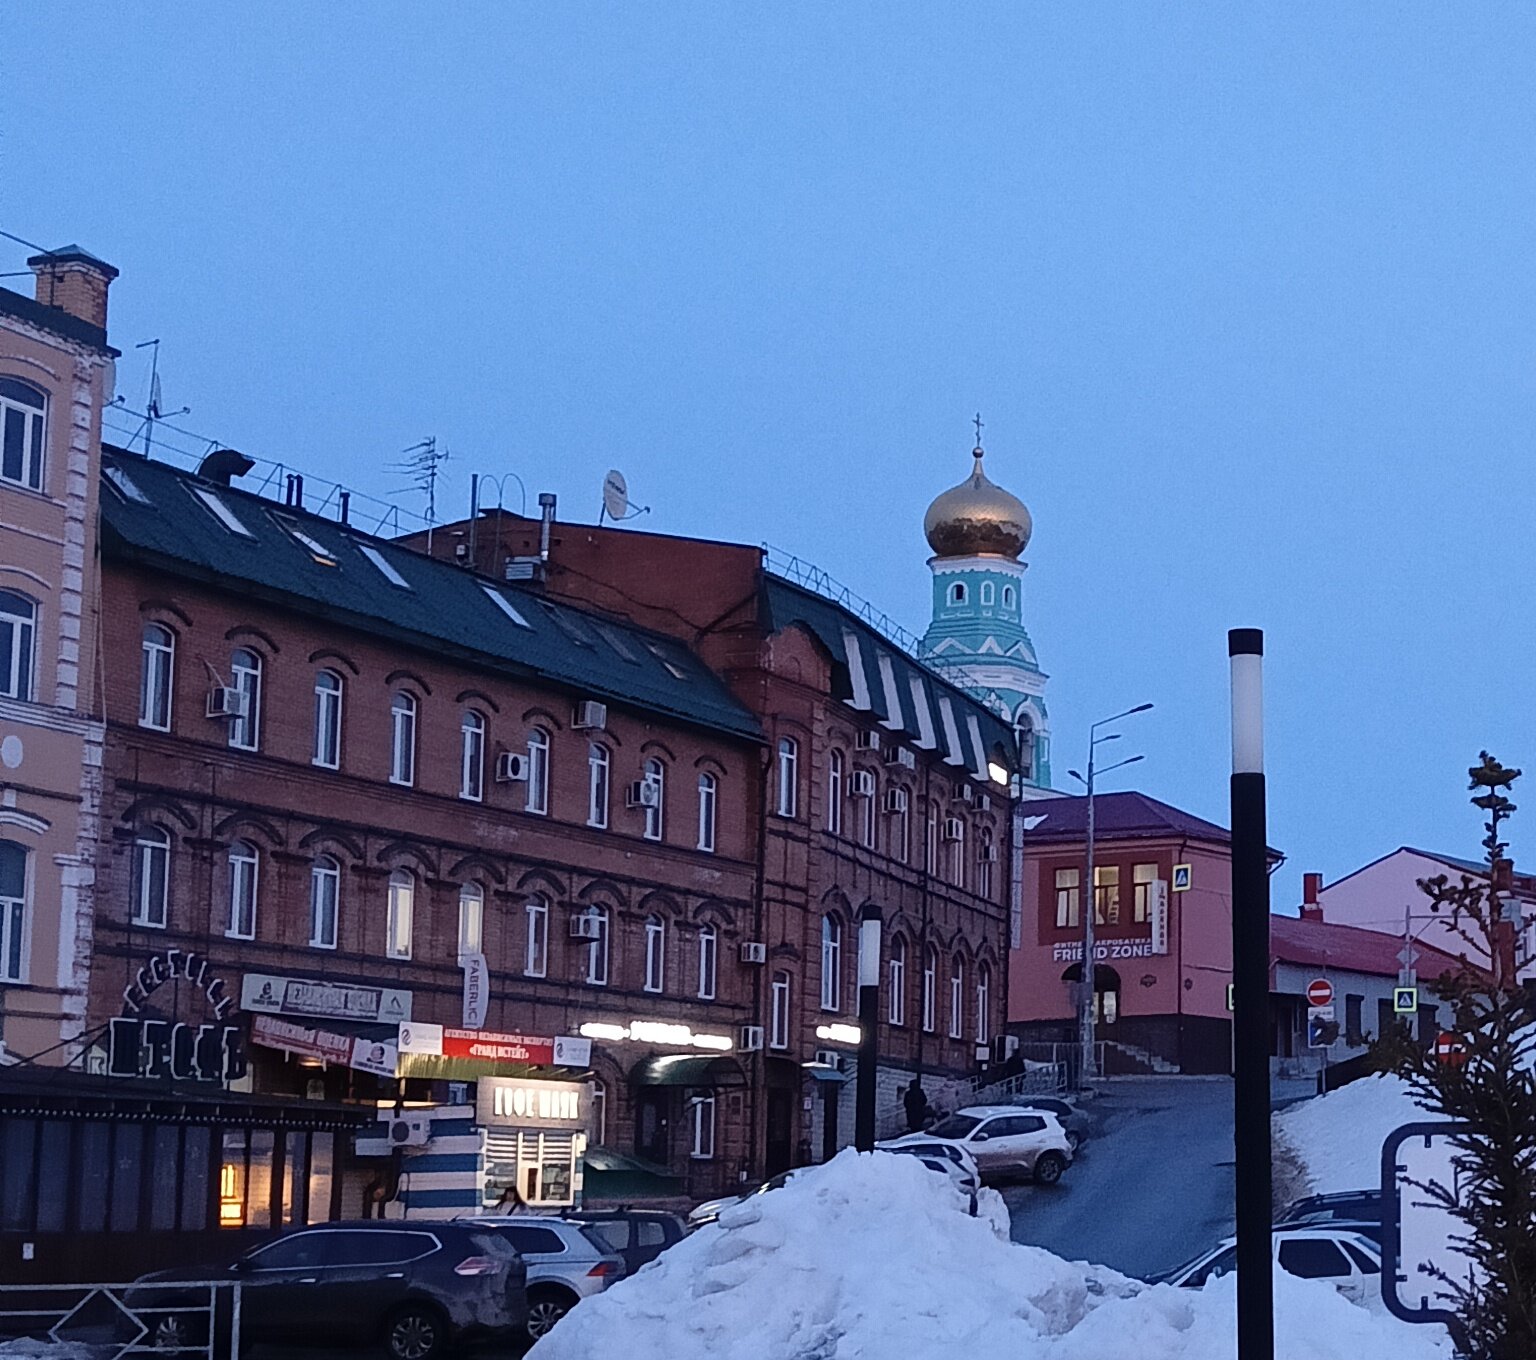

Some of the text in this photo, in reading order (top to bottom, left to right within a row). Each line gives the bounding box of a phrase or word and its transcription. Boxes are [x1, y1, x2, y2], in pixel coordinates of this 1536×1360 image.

[1054, 941, 1083, 949] ФИТНЕ
[1111, 944, 1152, 958] ZONE
[468, 959, 480, 1020] FABERLIC
